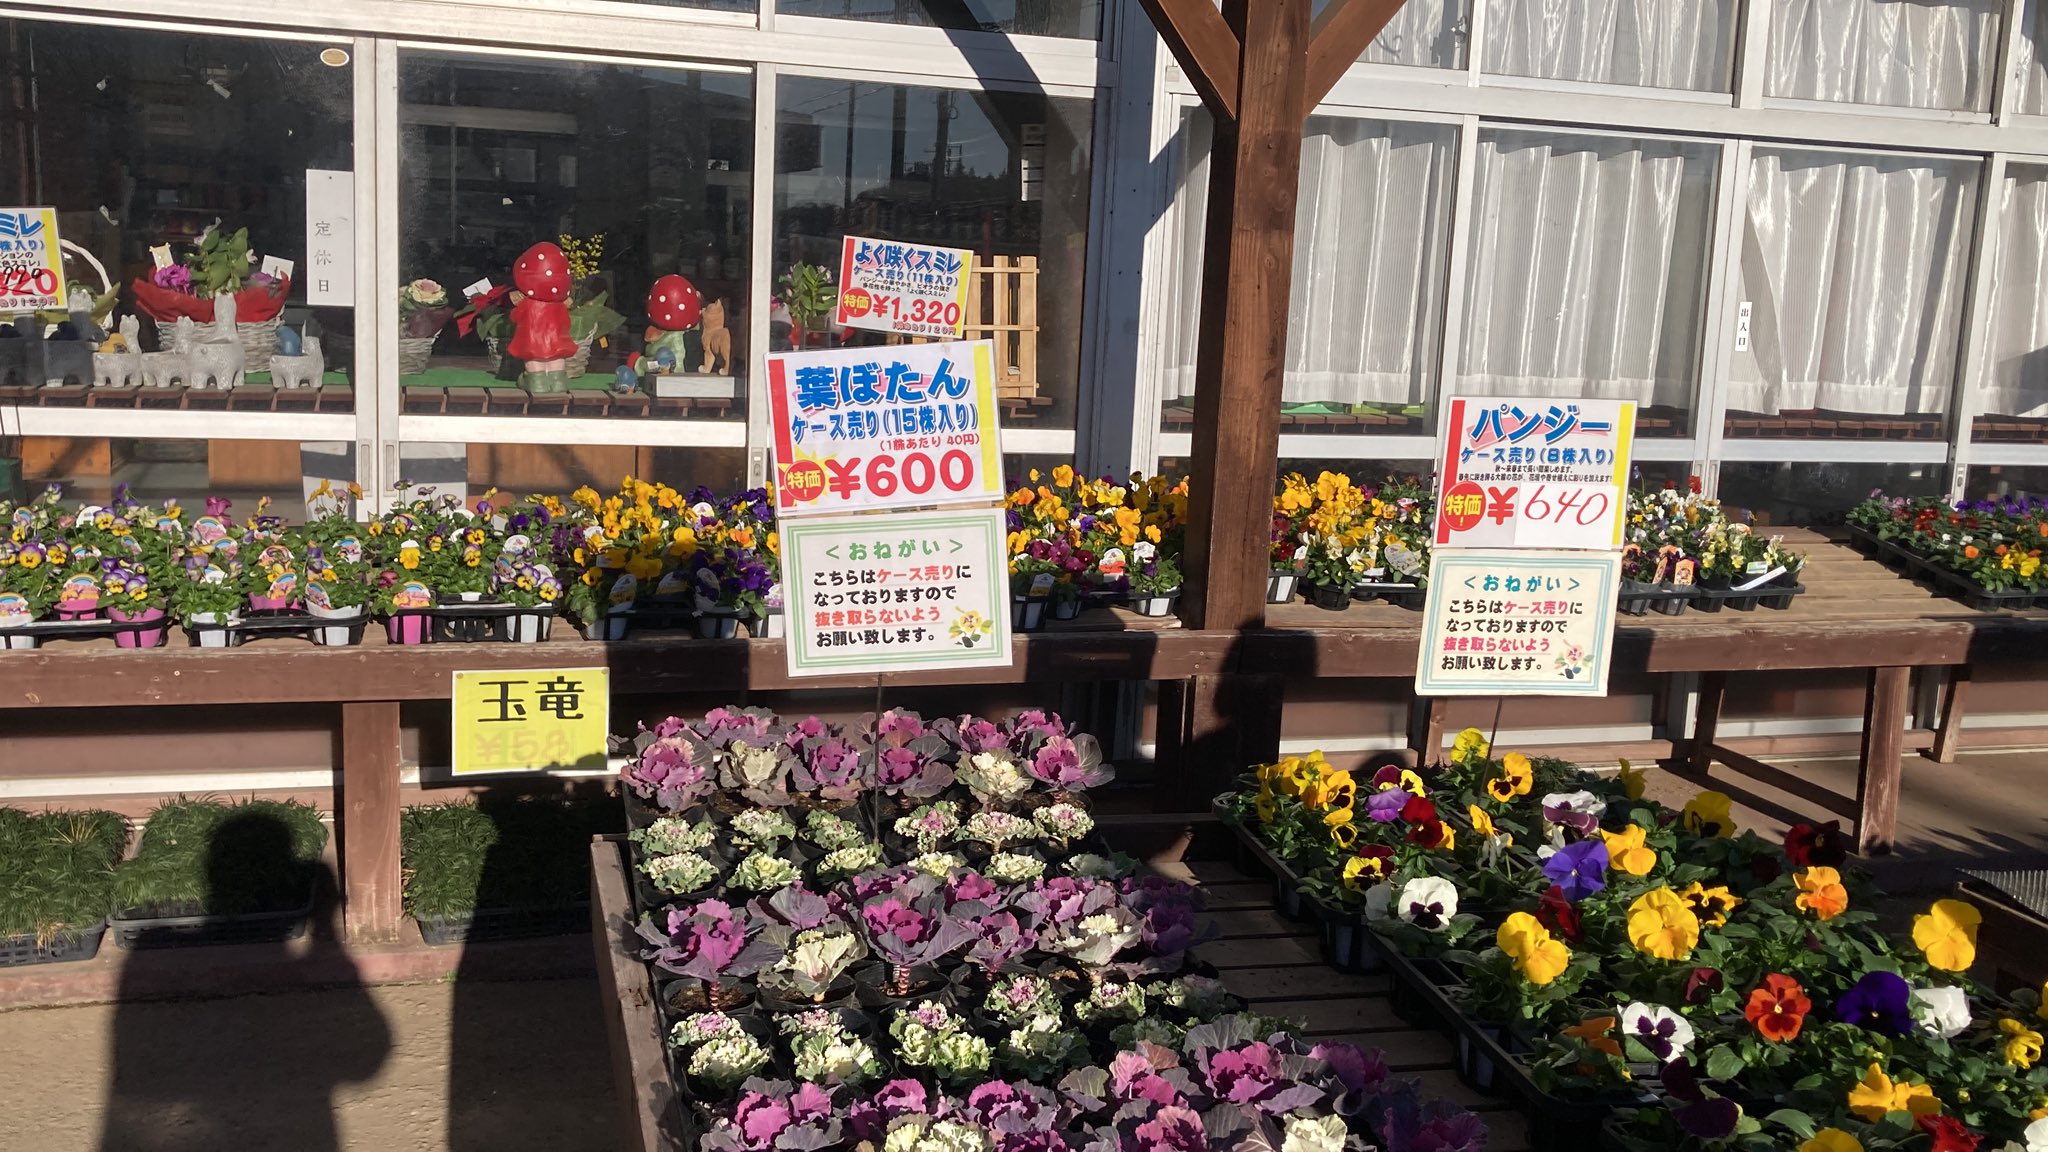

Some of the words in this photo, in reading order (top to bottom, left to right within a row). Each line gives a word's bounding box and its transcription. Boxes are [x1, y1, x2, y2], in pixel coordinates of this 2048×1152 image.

[0, 212, 44, 237] ミレ
[314, 220, 332, 293] 定休日
[855, 241, 963, 276] よく咲くスミレ
[853, 265, 958, 287] ケース売り(11株入り)
[873, 294, 961, 326] ¥1,320
[1738, 308, 1749, 346] 出入口
[795, 358, 970, 411] 葉ぼたん
[791, 403, 979, 445] ケース売り(15株入り)
[1470, 403, 1612, 445] パンジー
[1460, 446, 1614, 465] ケース売り(8株入り)
[824, 449, 974, 500] ¥600
[813, 564, 972, 586] こちらはケース売りに
[814, 586, 957, 606] なっておりますので
[1449, 599, 1583, 615] こちらはケース売りに
[815, 606, 942, 627] 抜き取らないよう
[1446, 618, 1568, 633] なっておりますので
[816, 627, 935, 648] お願い致します。
[1443, 637, 1551, 652] 抜き取らないよう
[1441, 656, 1543, 671] お願い致します。
[477, 675, 585, 722] 玉竜
